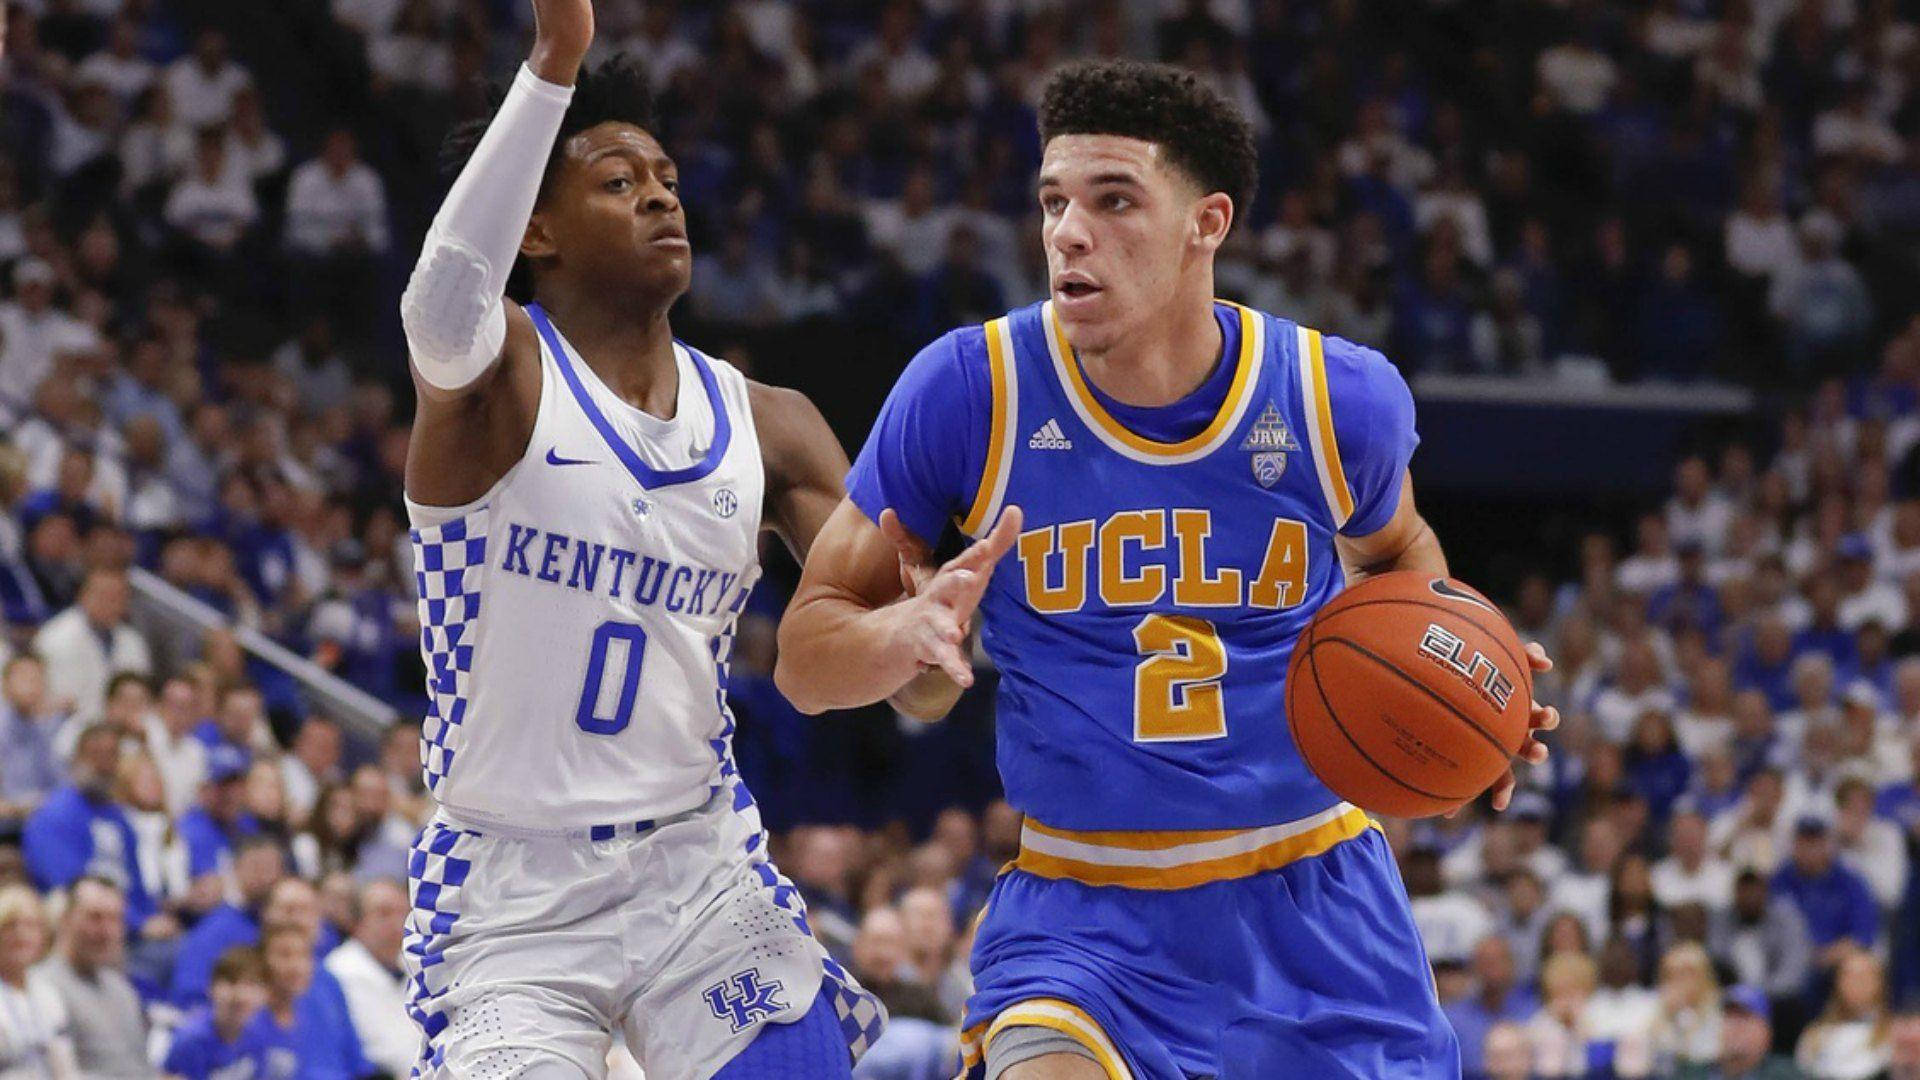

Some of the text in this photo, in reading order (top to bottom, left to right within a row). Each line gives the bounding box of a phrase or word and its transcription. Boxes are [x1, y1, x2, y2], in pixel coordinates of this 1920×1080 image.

[1029, 438, 1072, 450] adidas
[1249, 429, 1288, 445] JRW
[502, 523, 737, 615] KENTUCKY
[1018, 509, 1309, 614] UCLA
[575, 620, 647, 736] 0
[1132, 613, 1228, 742] 2
[1419, 623, 1515, 711] ELITE
[702, 967, 791, 1034] UK
